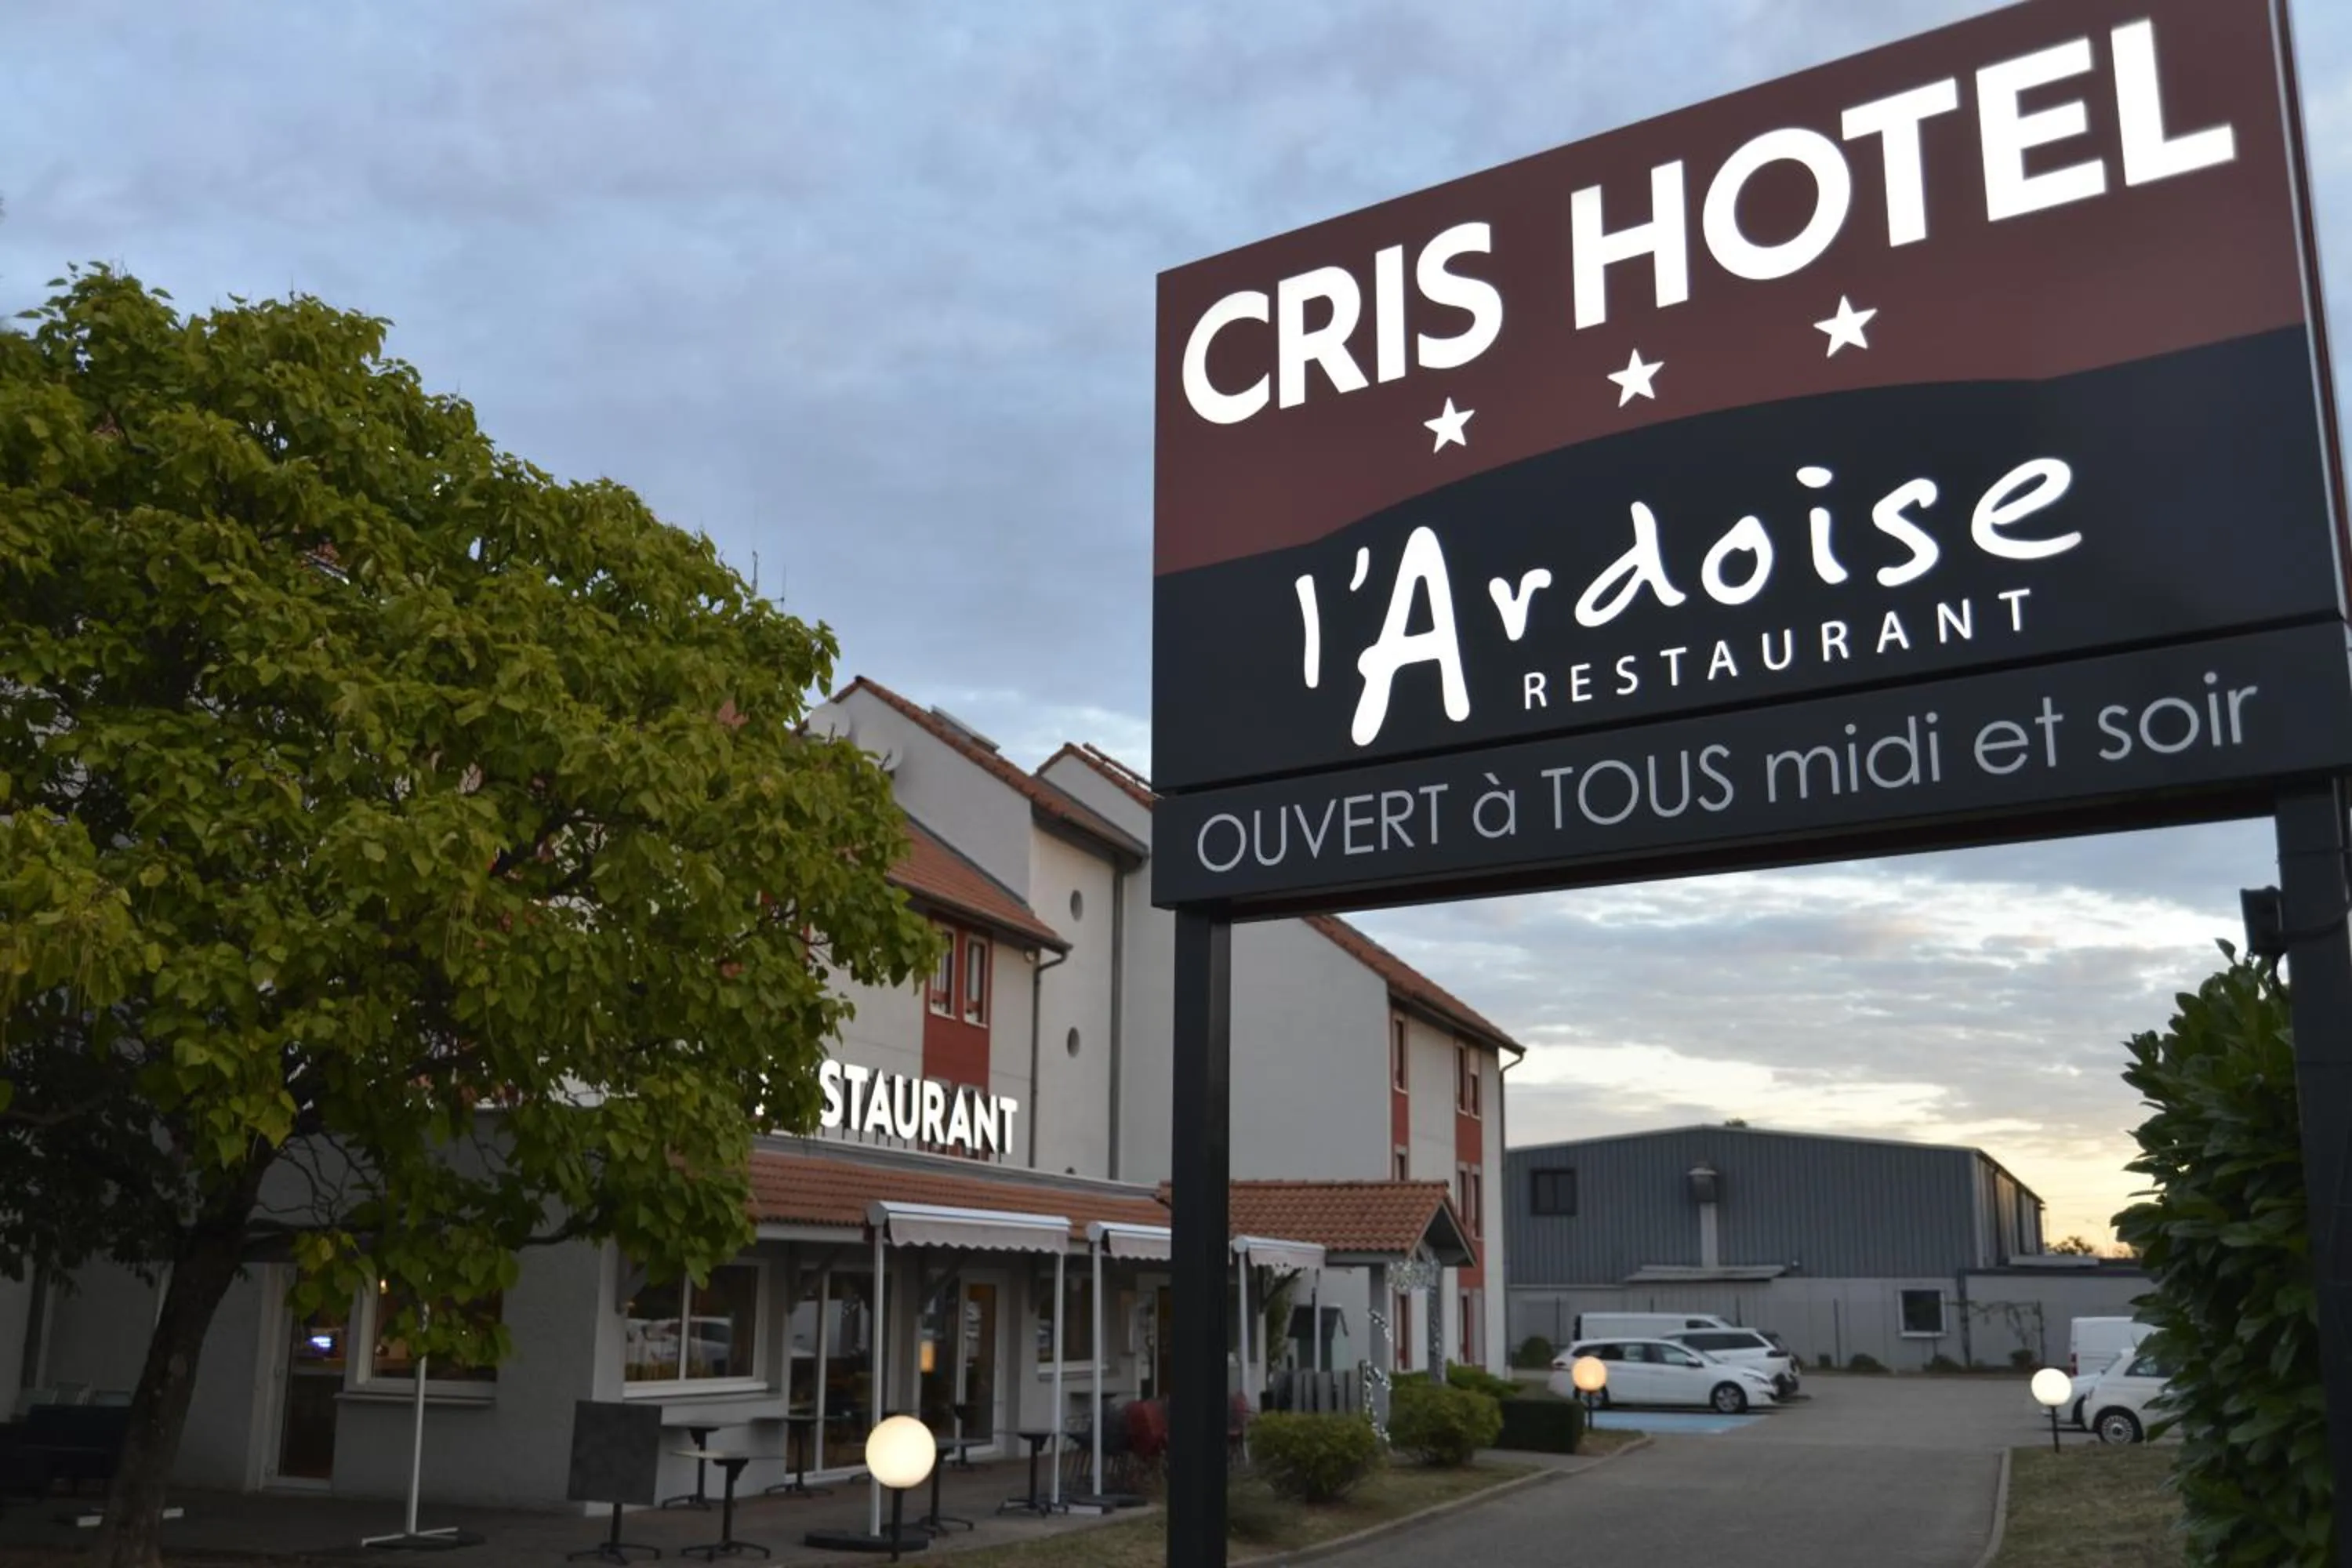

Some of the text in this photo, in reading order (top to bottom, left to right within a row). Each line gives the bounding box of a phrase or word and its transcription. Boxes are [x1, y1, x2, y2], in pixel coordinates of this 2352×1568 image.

[1181, 16, 2238, 425] CRIS HOTEL
[1523, 588, 2031, 710] RESTAURANT
[1197, 672, 2257, 872] OUVERT à TOUS midi et soir
[754, 1054, 1018, 1155] STAURANT
